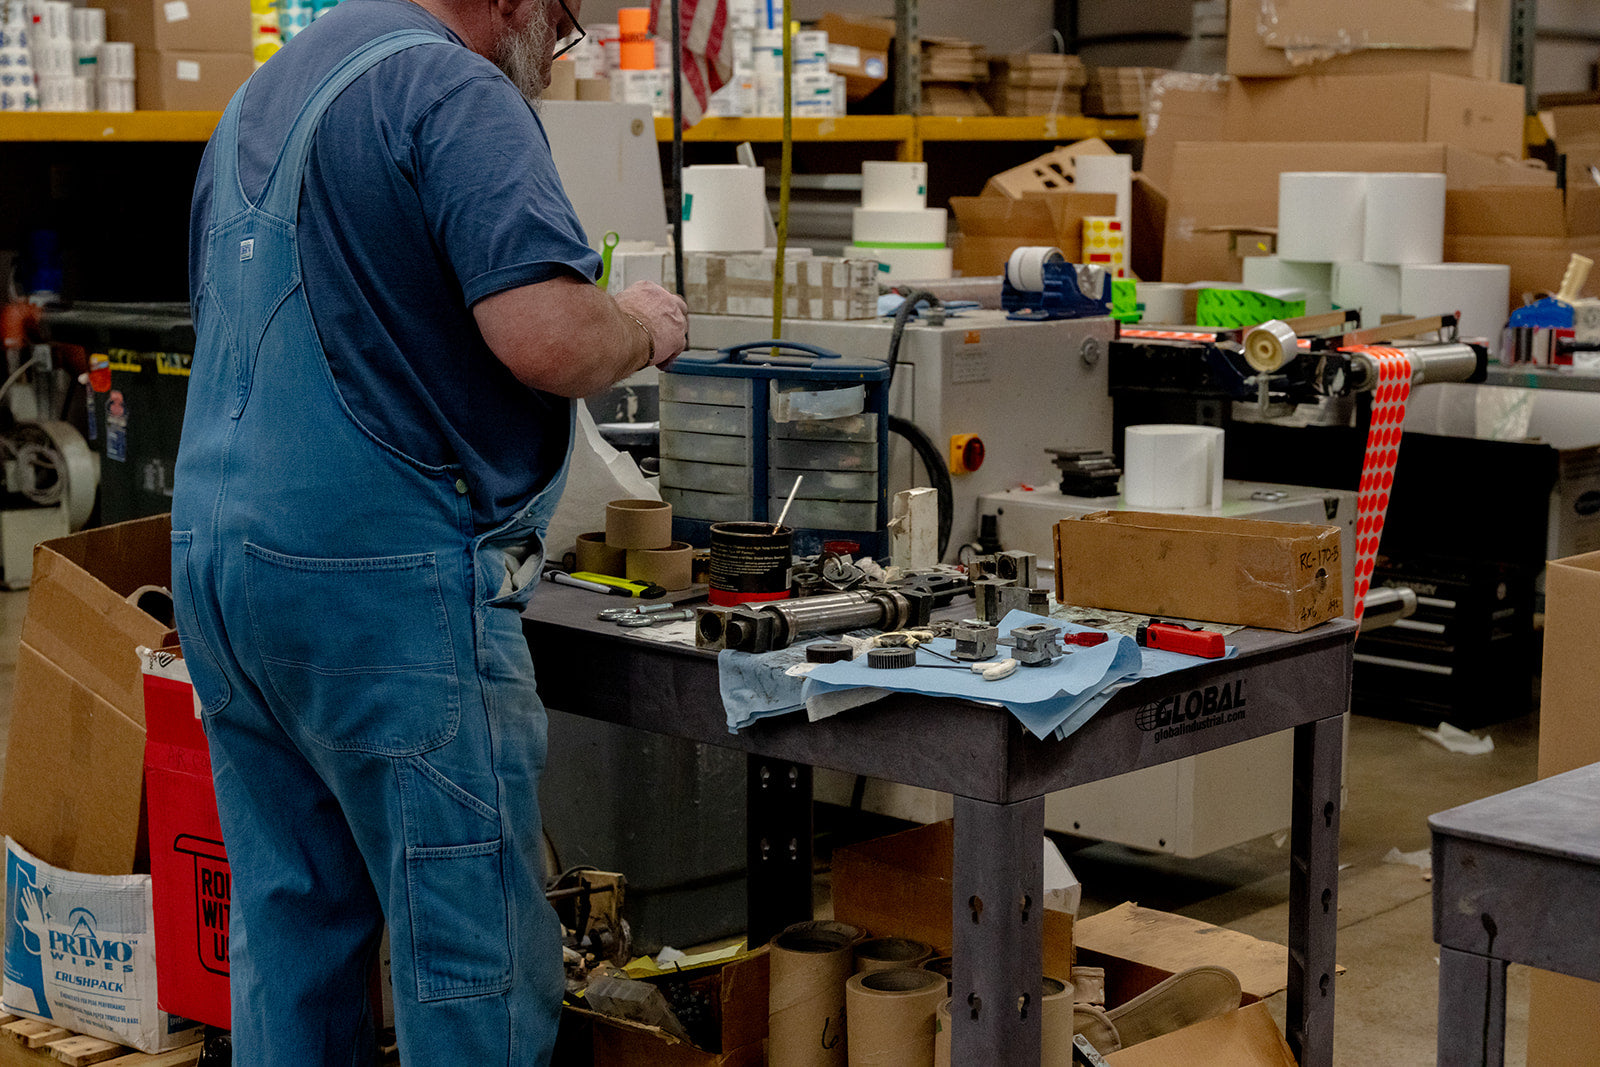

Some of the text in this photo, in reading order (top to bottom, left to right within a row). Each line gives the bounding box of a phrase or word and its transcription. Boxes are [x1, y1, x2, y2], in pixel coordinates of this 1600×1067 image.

[1156, 680, 1247, 727] GLOBAL
[1154, 710, 1246, 744] globalindustrial.com
[49, 930, 132, 962] PRIMO
[50, 951, 134, 973] WIPES
[55, 970, 123, 993] CRUSHPACK
